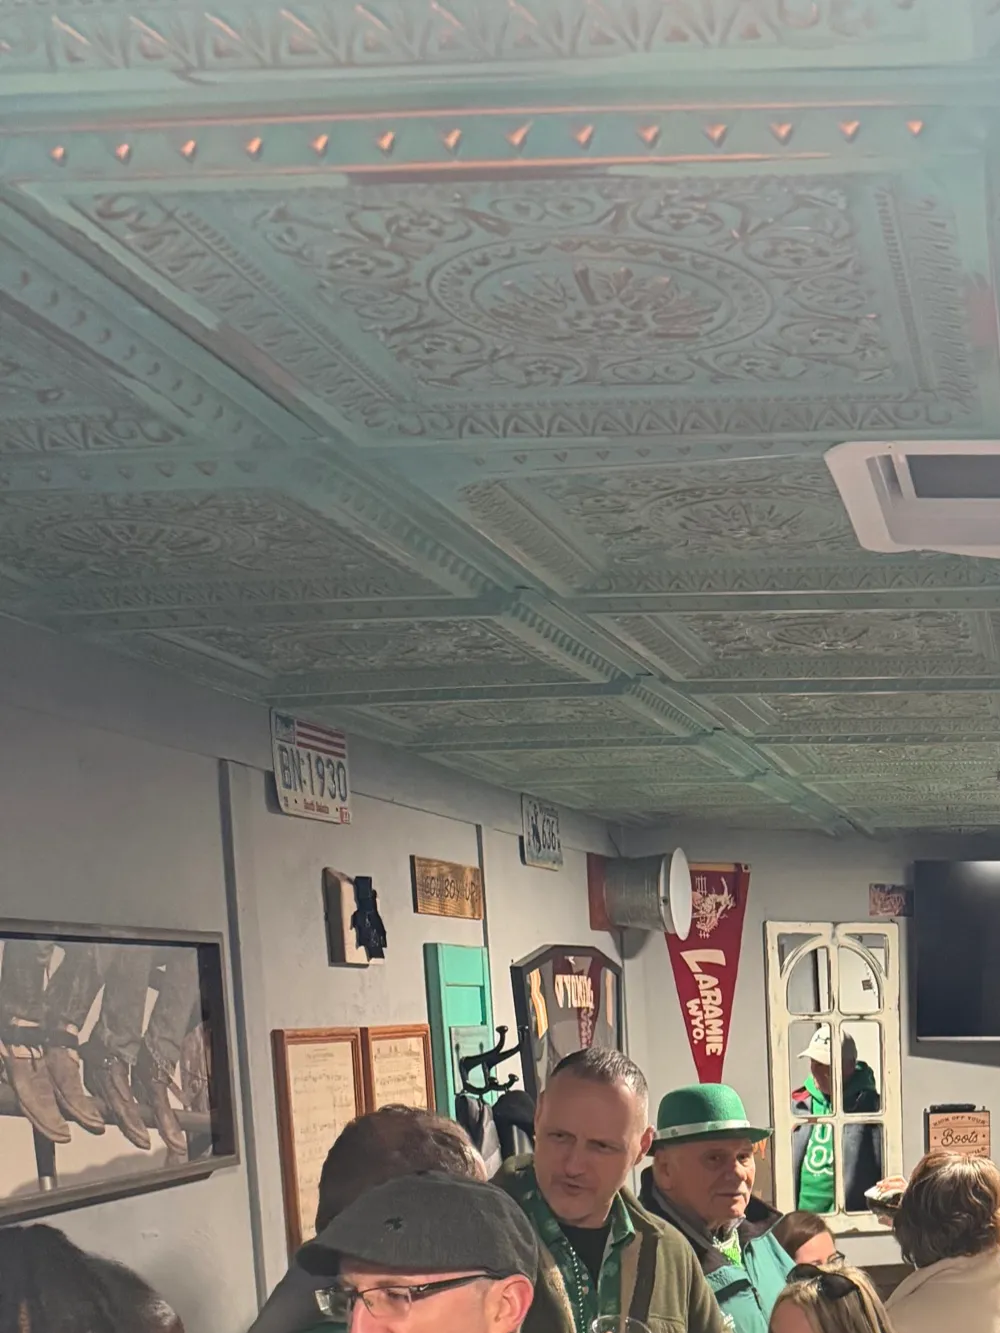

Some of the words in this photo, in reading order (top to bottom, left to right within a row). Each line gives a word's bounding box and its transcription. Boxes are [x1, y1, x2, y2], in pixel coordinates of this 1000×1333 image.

[680, 949, 727, 1056] LARAMIE
[686, 998, 705, 1045] WYO.
[941, 1128, 978, 1147] Boots
